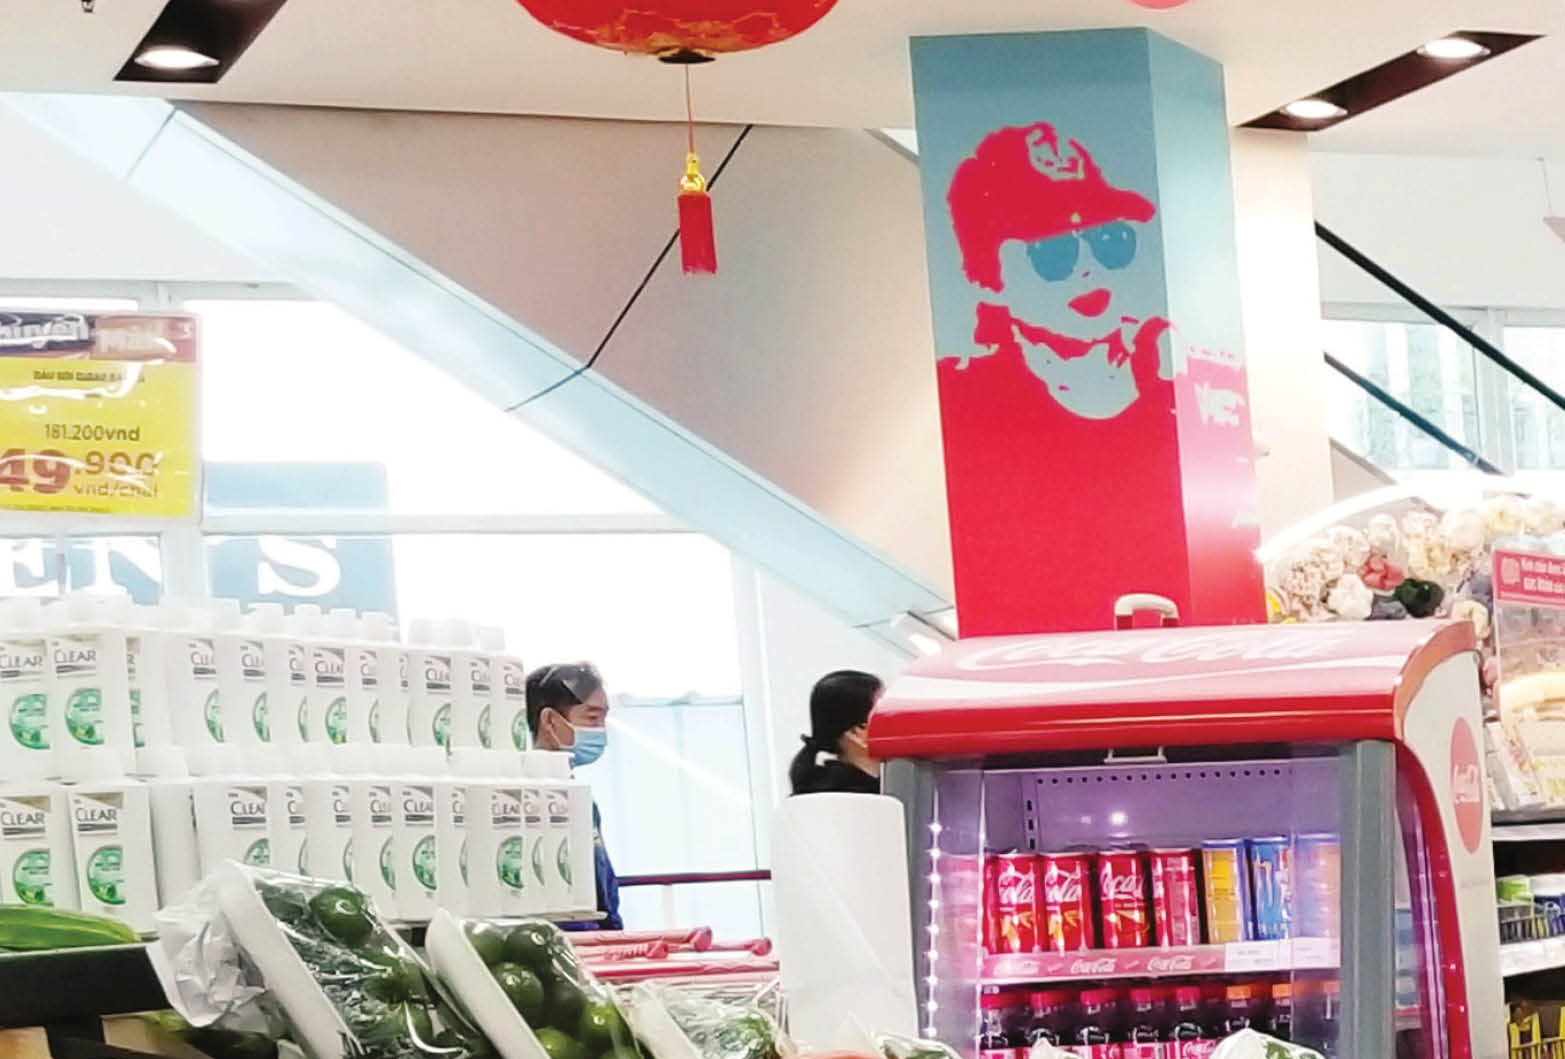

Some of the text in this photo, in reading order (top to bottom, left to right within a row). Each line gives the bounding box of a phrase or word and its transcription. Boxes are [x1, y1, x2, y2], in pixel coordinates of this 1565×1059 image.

[0, 653, 43, 670] CLEAR
[54, 647, 97, 664] CLEAR
[0, 810, 45, 827] CLEAR
[75, 807, 118, 823] CLEAR
